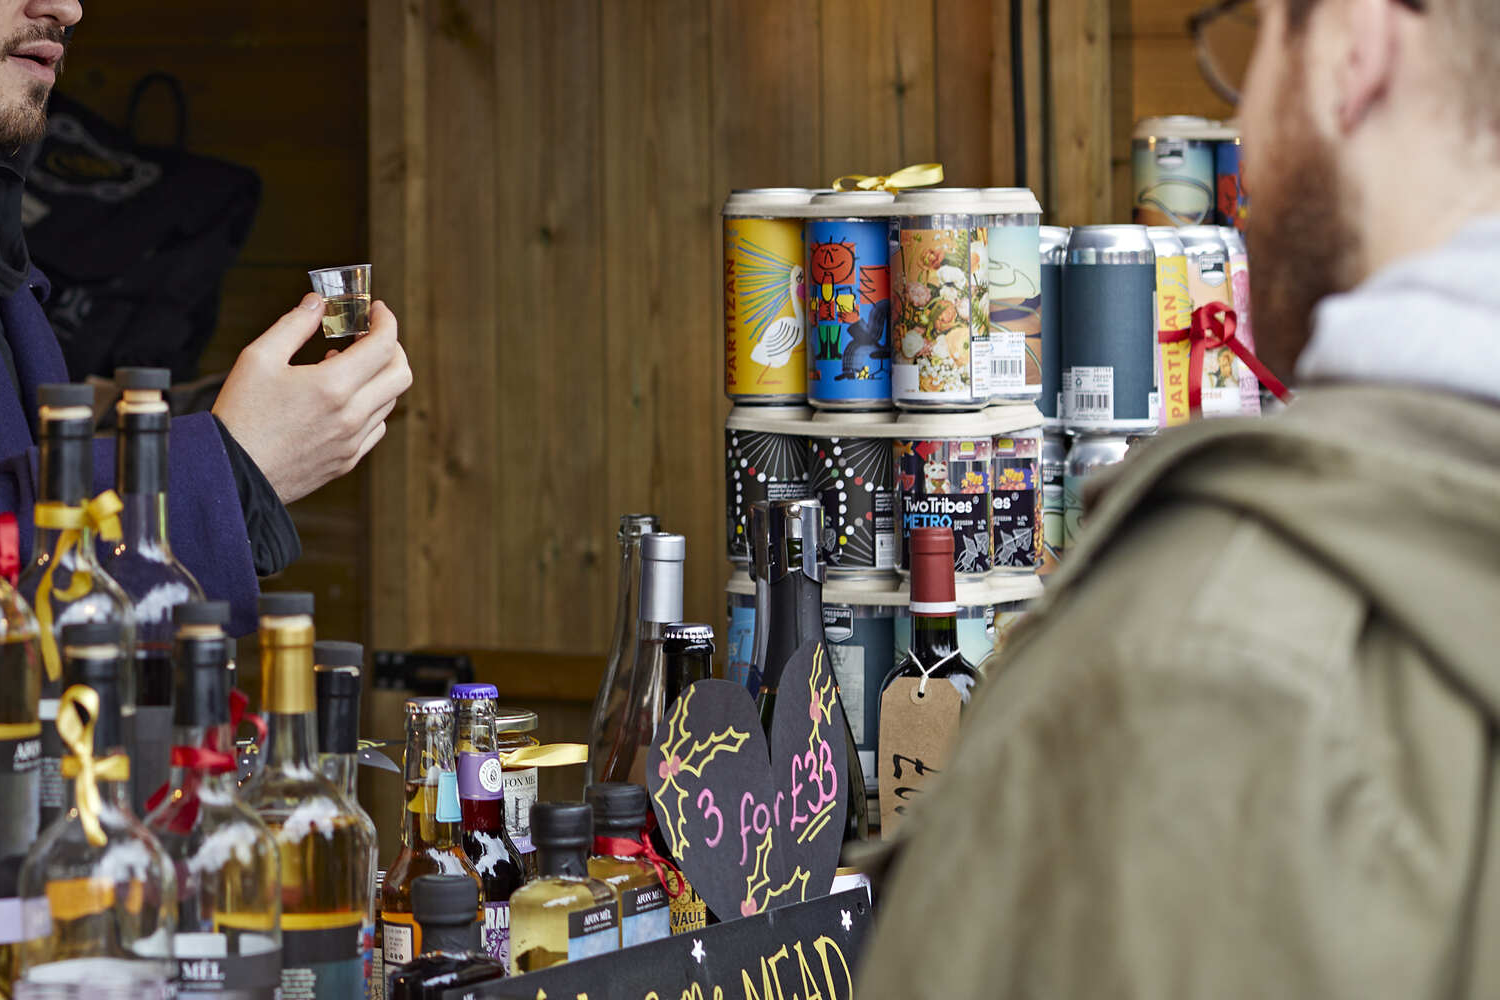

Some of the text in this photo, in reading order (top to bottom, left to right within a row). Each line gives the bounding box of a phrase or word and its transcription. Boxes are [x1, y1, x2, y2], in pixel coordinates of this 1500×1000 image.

[726, 259, 738, 387] PARTIZAN
[1163, 295, 1185, 419] PARTIAN
[903, 514, 953, 529] METRO
[697, 740, 838, 866] 3 for £33
